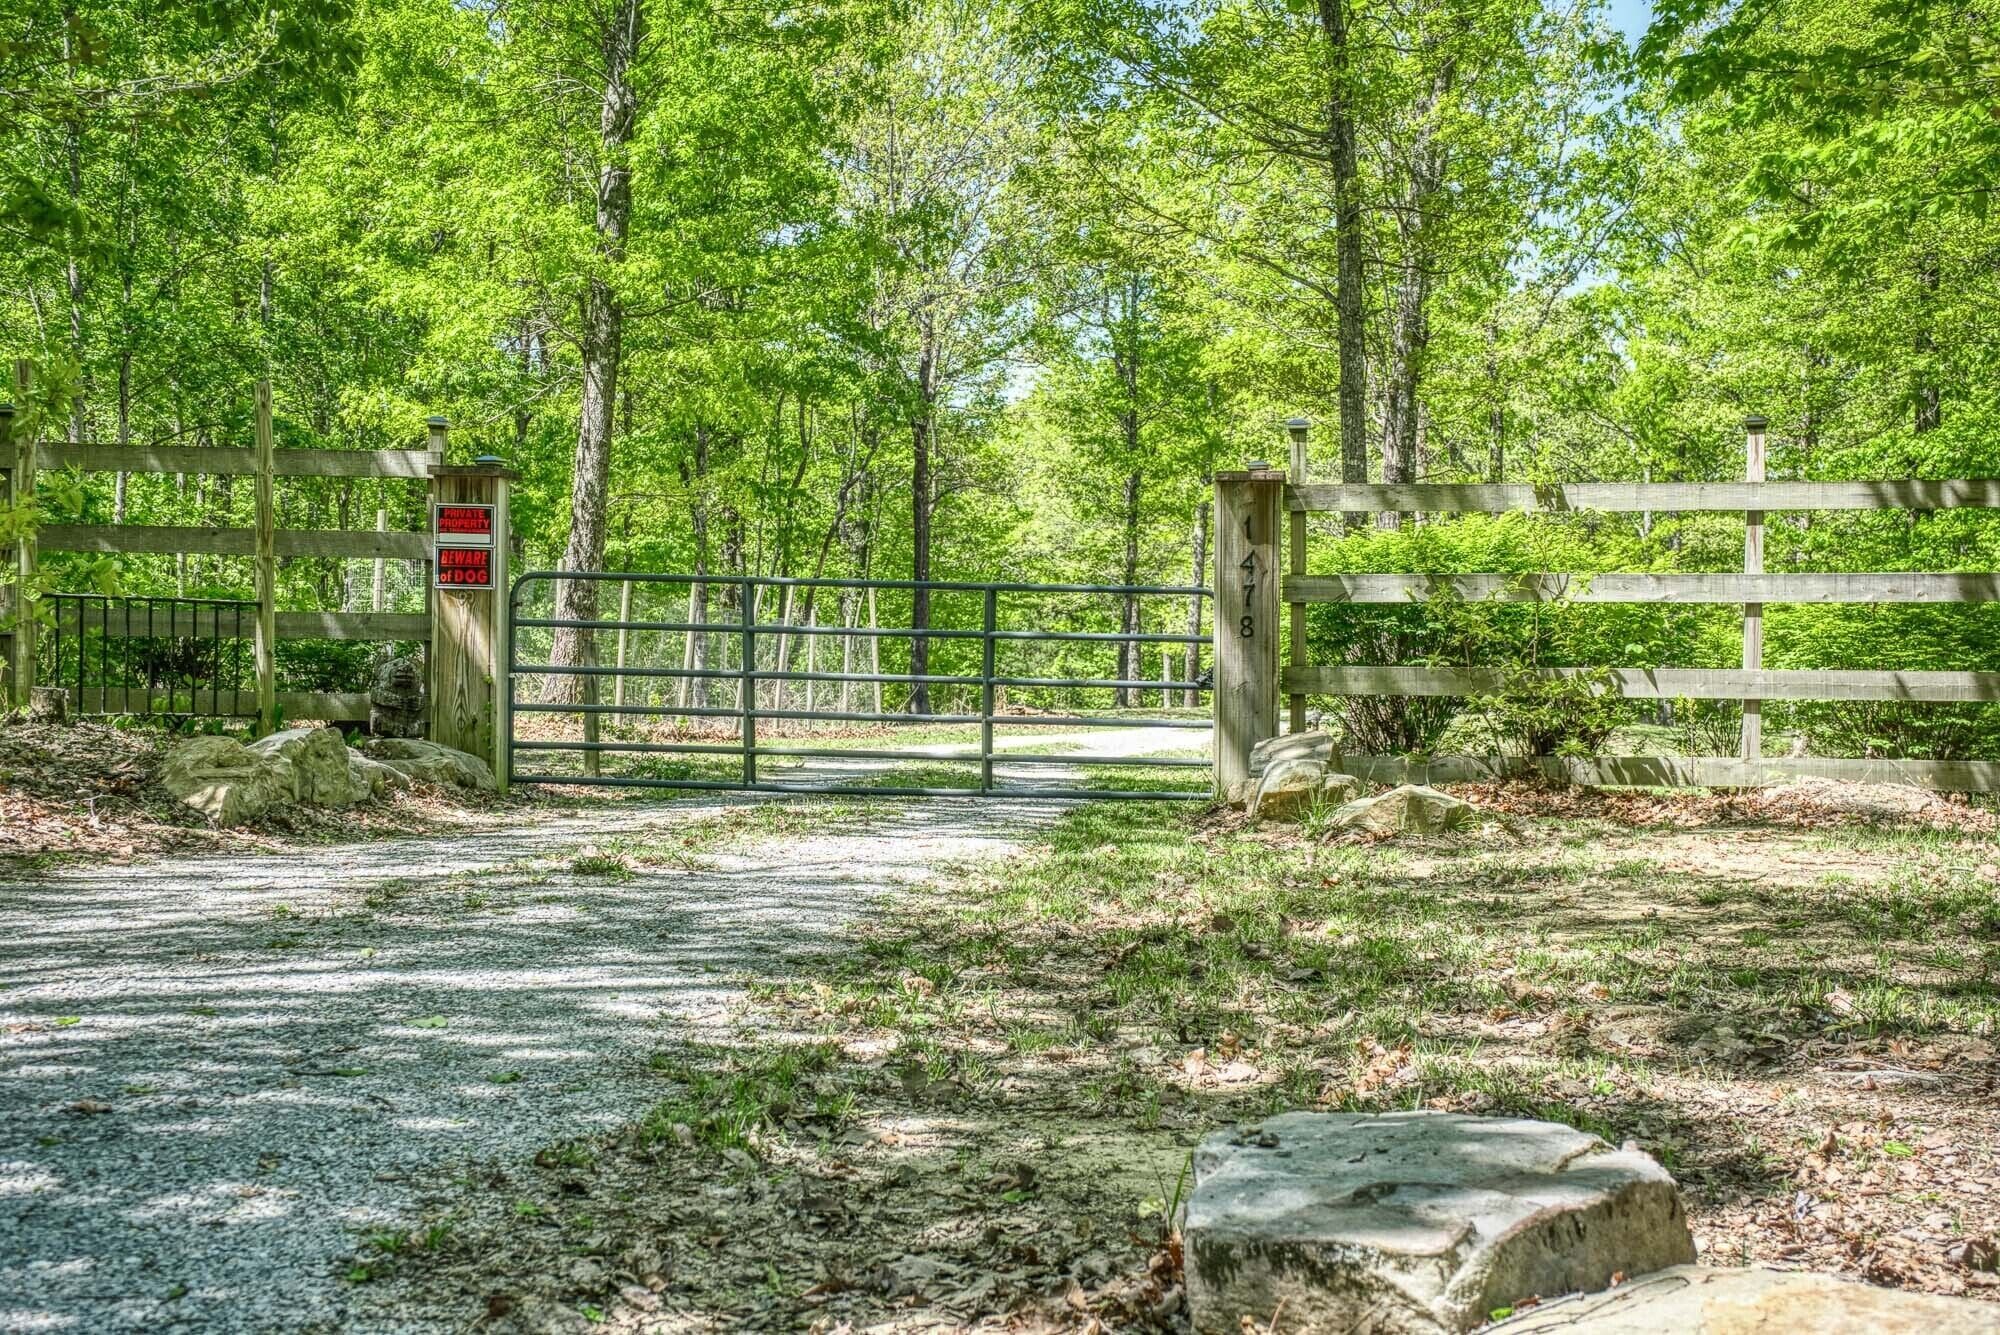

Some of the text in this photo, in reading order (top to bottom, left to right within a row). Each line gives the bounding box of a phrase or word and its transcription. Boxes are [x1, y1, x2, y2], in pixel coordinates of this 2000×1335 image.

[444, 508, 485, 518] PRIVATE
[439, 518, 490, 529] PROPERTY
[440, 550, 488, 565] BEWARE
[440, 569, 488, 583] of DOG
[1240, 515, 1256, 638] 1478
